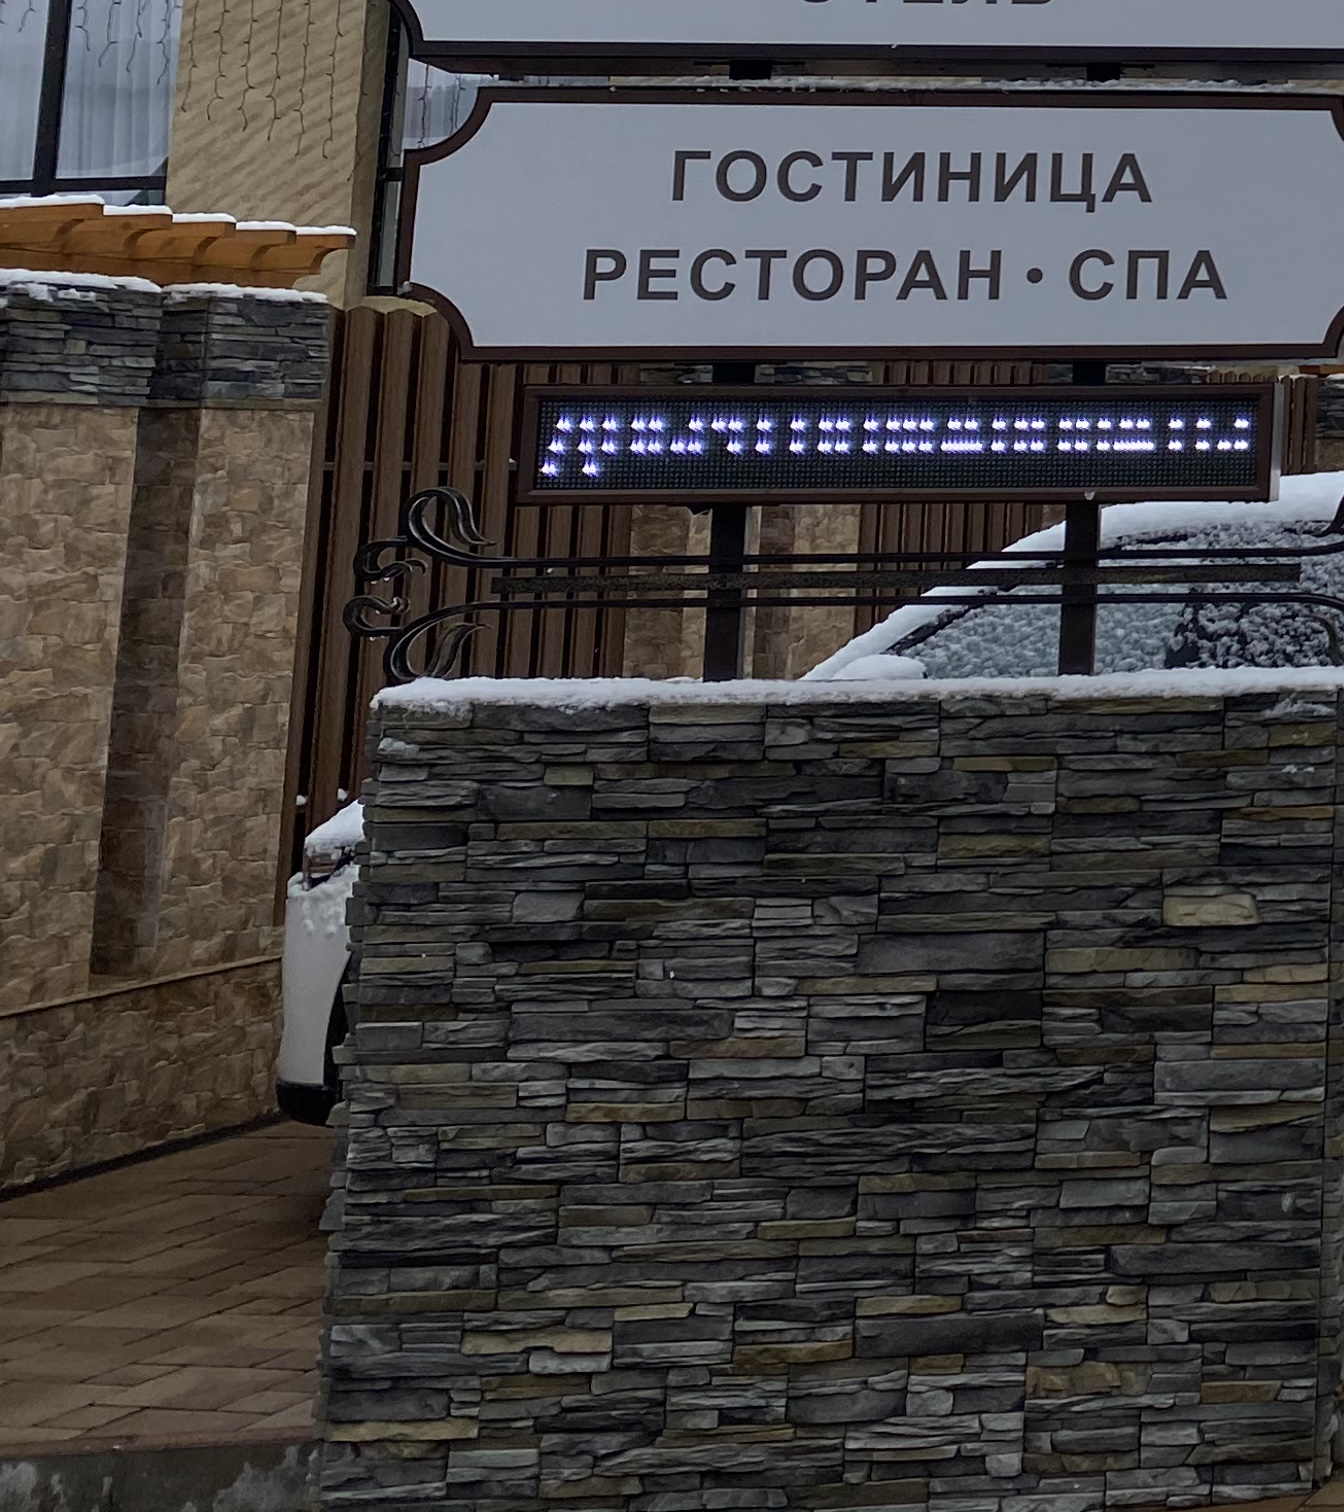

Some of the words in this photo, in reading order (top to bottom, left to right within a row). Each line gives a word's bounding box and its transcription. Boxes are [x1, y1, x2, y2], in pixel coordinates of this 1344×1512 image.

[671, 148, 1153, 215] ГОСТИНИЦА
[582, 247, 1003, 302] РЕСТОРАН
[1067, 247, 1229, 301] СПА
